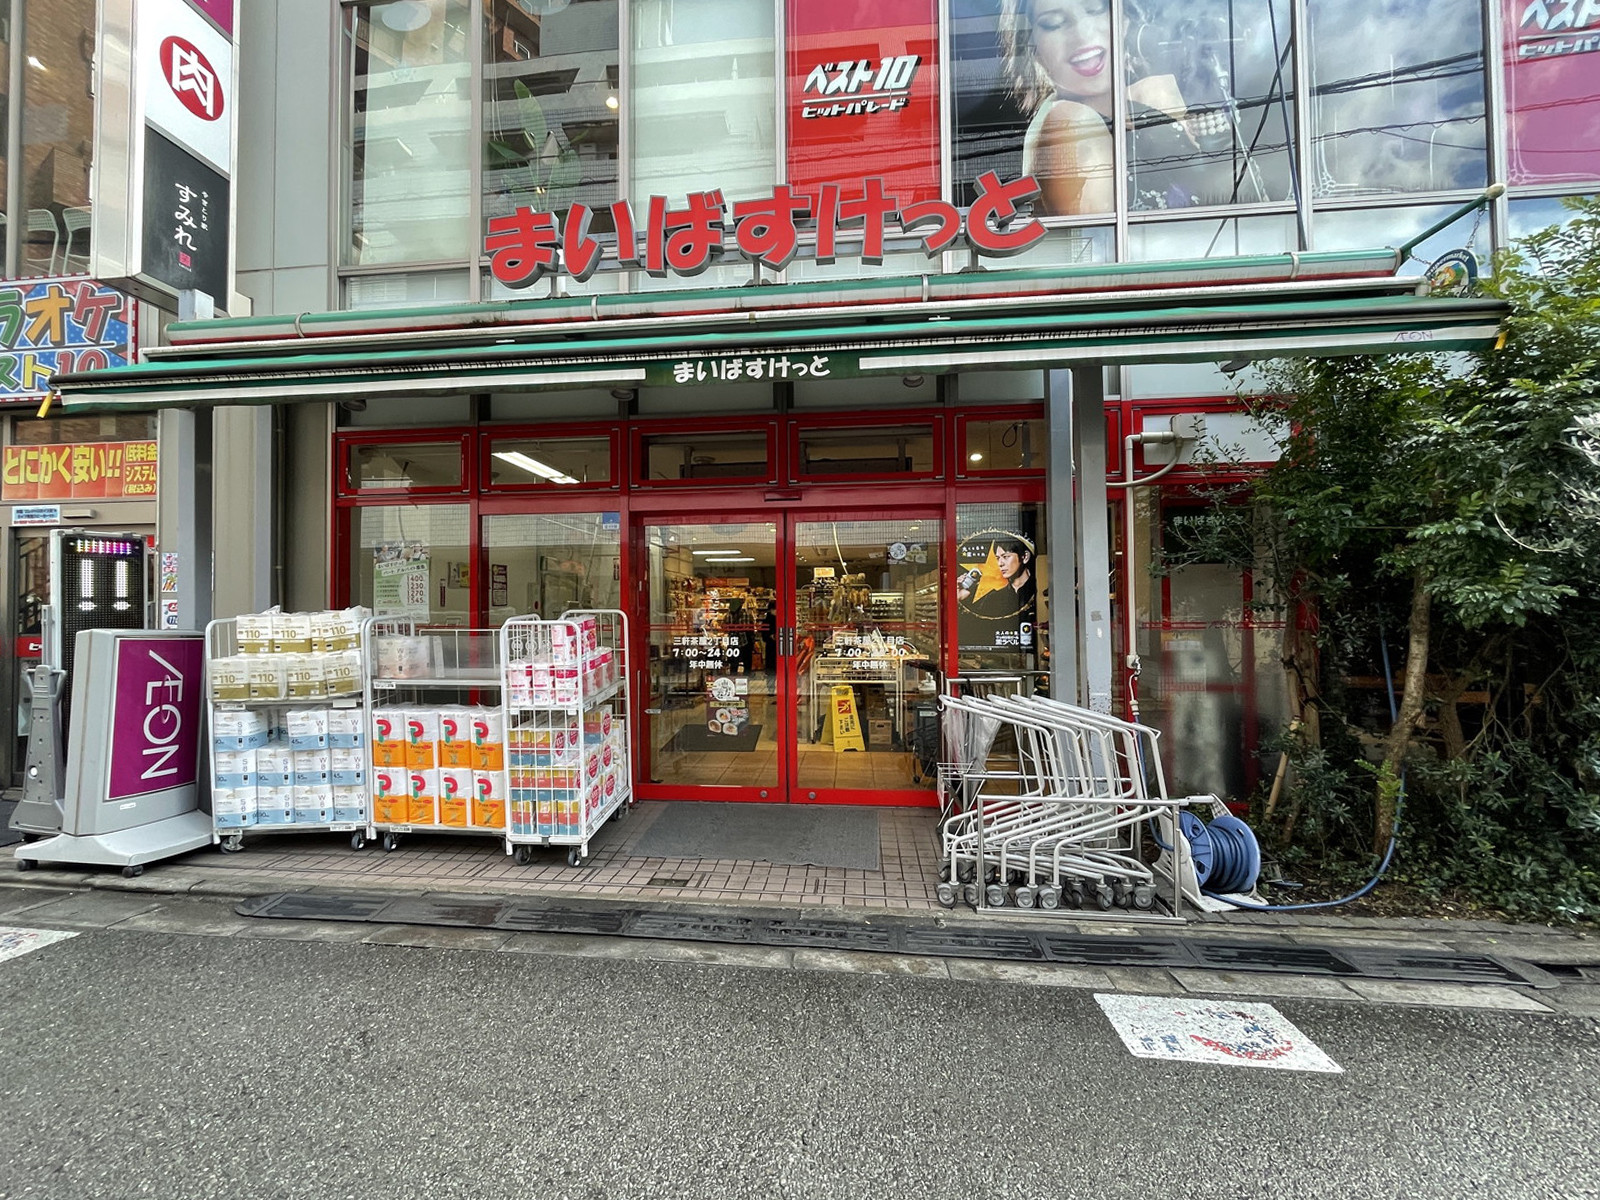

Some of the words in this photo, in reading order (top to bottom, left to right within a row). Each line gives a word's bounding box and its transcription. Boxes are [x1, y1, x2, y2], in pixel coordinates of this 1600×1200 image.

[1519, 36, 1600, 56] ヒットパ
[171, 42, 214, 118] 肉
[803, 55, 921, 95] ベスト10
[801, 98, 909, 119] ヒットパレード
[174, 183, 198, 251] すみれ
[484, 168, 1049, 290] まいばすけっと
[673, 355, 831, 384] まいばすけっと
[125, 466, 157, 482] システム
[673, 637, 739, 646] 三軒茶屋2丁目店
[689, 660, 723, 670] 年中無休
[852, 660, 888, 670] 年中無休
